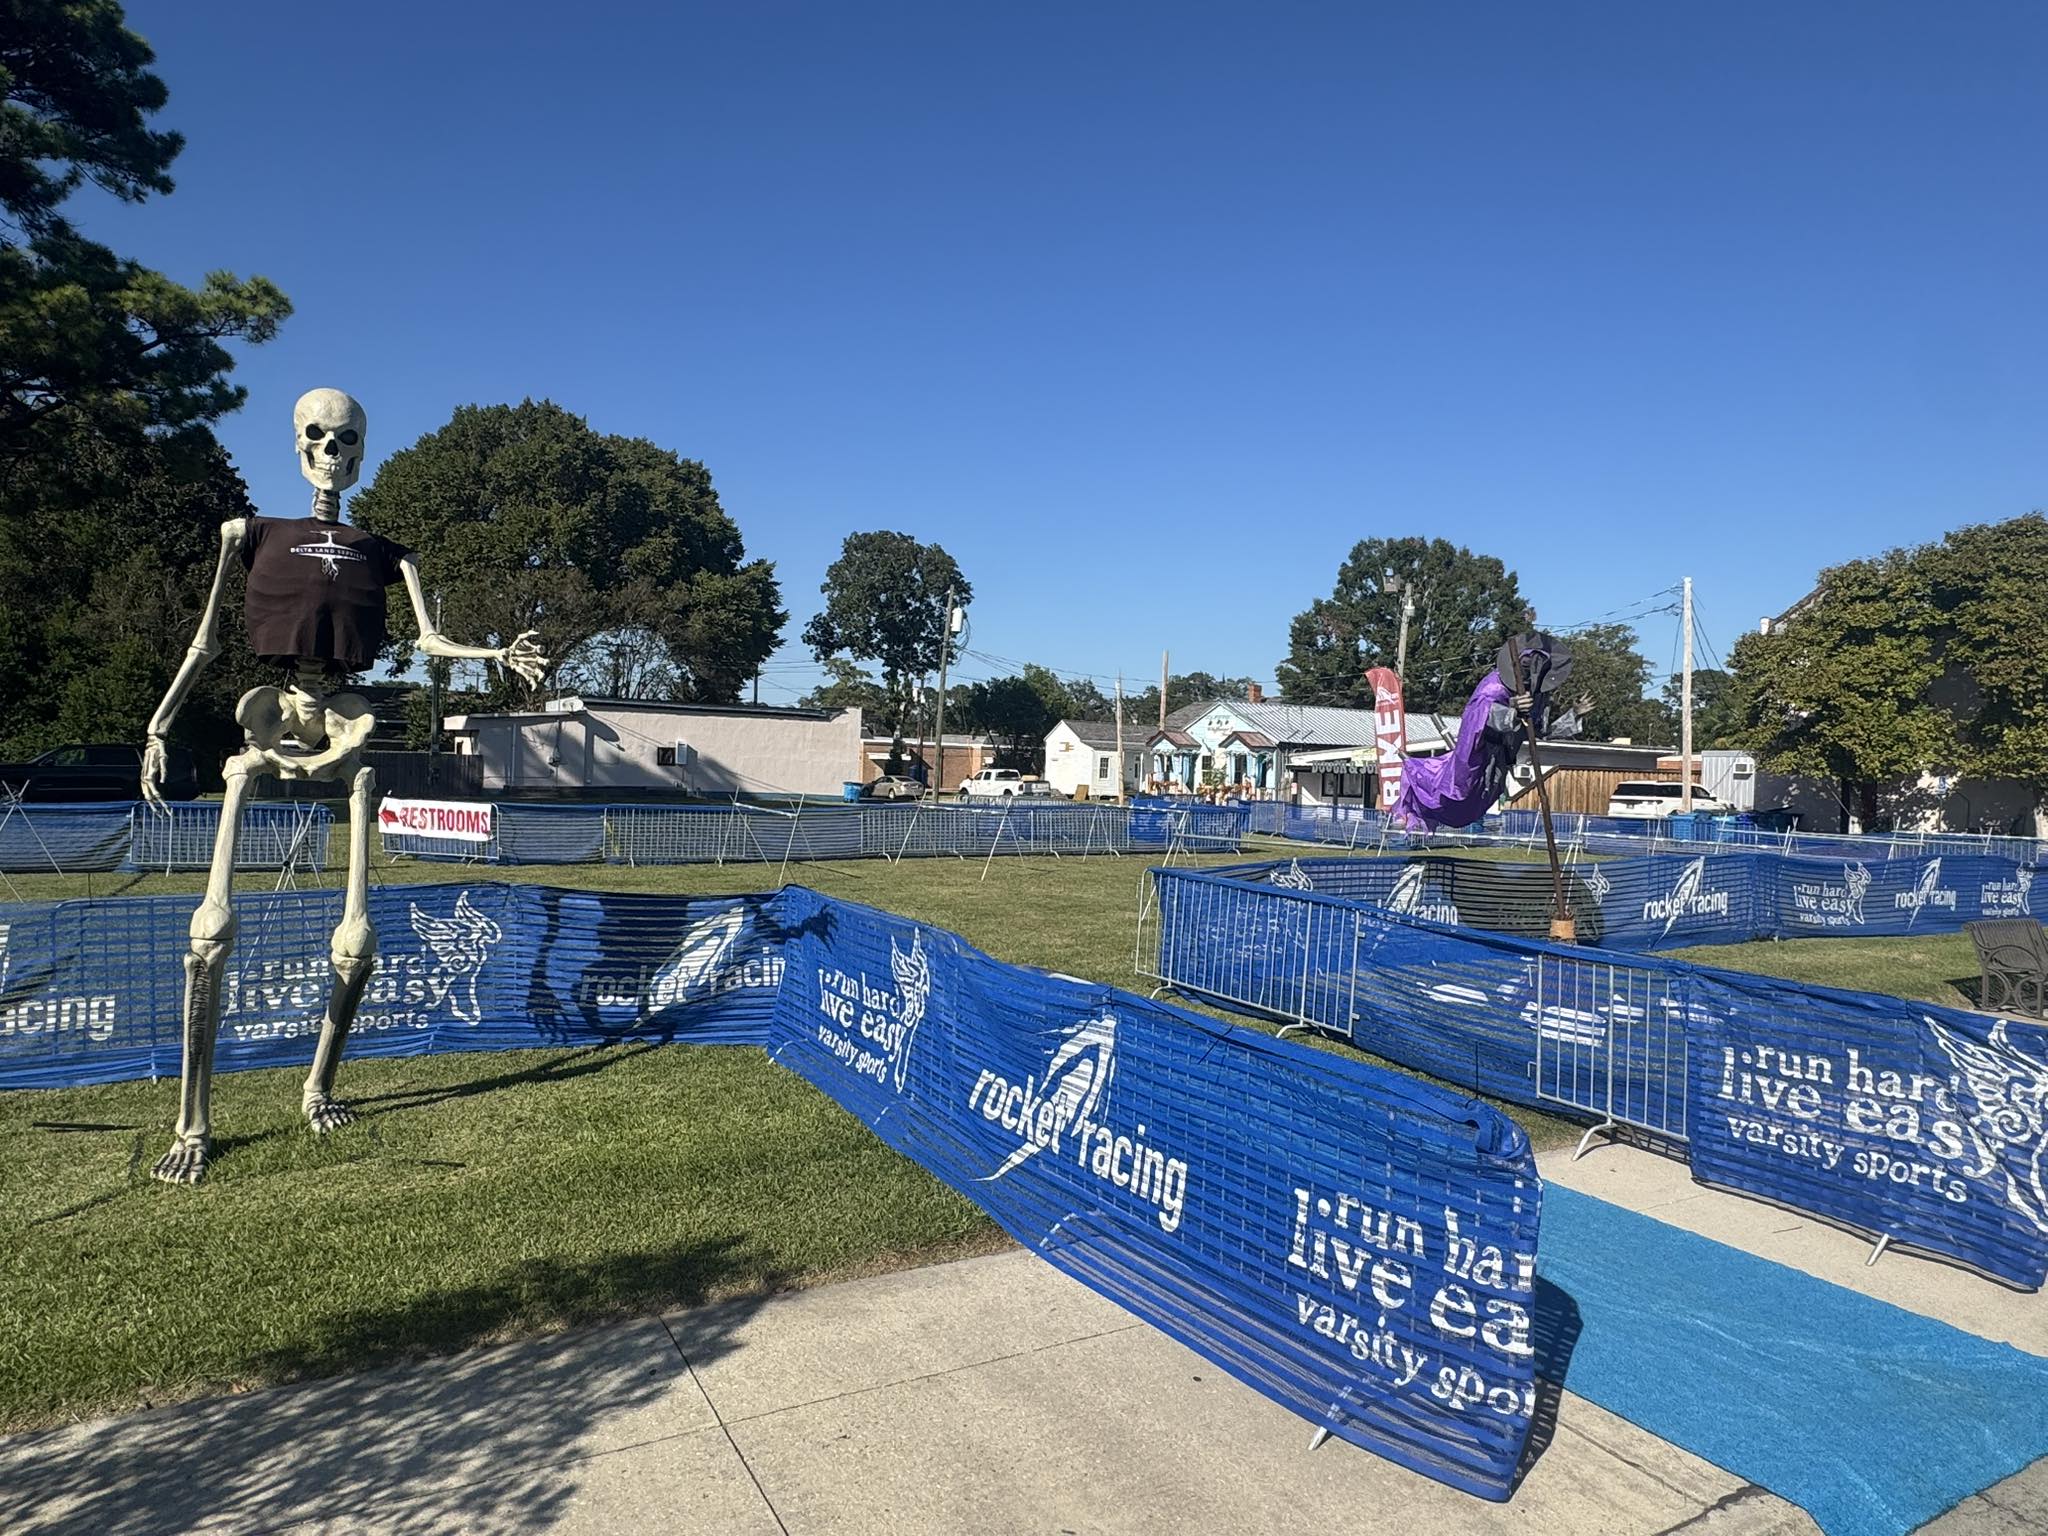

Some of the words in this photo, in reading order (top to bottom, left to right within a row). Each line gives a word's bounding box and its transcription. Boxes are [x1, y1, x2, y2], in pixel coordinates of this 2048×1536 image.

[1375, 709, 1402, 805] BIKE
[400, 806, 492, 835] RESTROOMS
[1643, 890, 1686, 921] rocket
[1691, 886, 1729, 916] racing
[1821, 898, 1856, 917] easy
[1895, 882, 1926, 909] rocket
[261, 958, 330, 980] run
[578, 963, 687, 1009] rocket
[709, 946, 786, 997] racin
[831, 969, 859, 1000] run
[861, 971, 901, 1018] hard
[818, 1025, 859, 1066] varsity
[855, 1052, 888, 1084] sports
[860, 1010, 907, 1063] easy
[1756, 1044, 1833, 1085] run
[1846, 1048, 1960, 1113] hard
[1717, 1046, 1823, 1119] live
[1846, 1096, 2006, 1179] easy
[968, 1068, 1069, 1156] rocket
[1078, 1123, 1189, 1233] racing
[1727, 1116, 1845, 1170] varsity
[1853, 1150, 1968, 1203] sports
[1333, 1191, 1427, 1260] run
[1296, 1292, 1428, 1387] varsity
